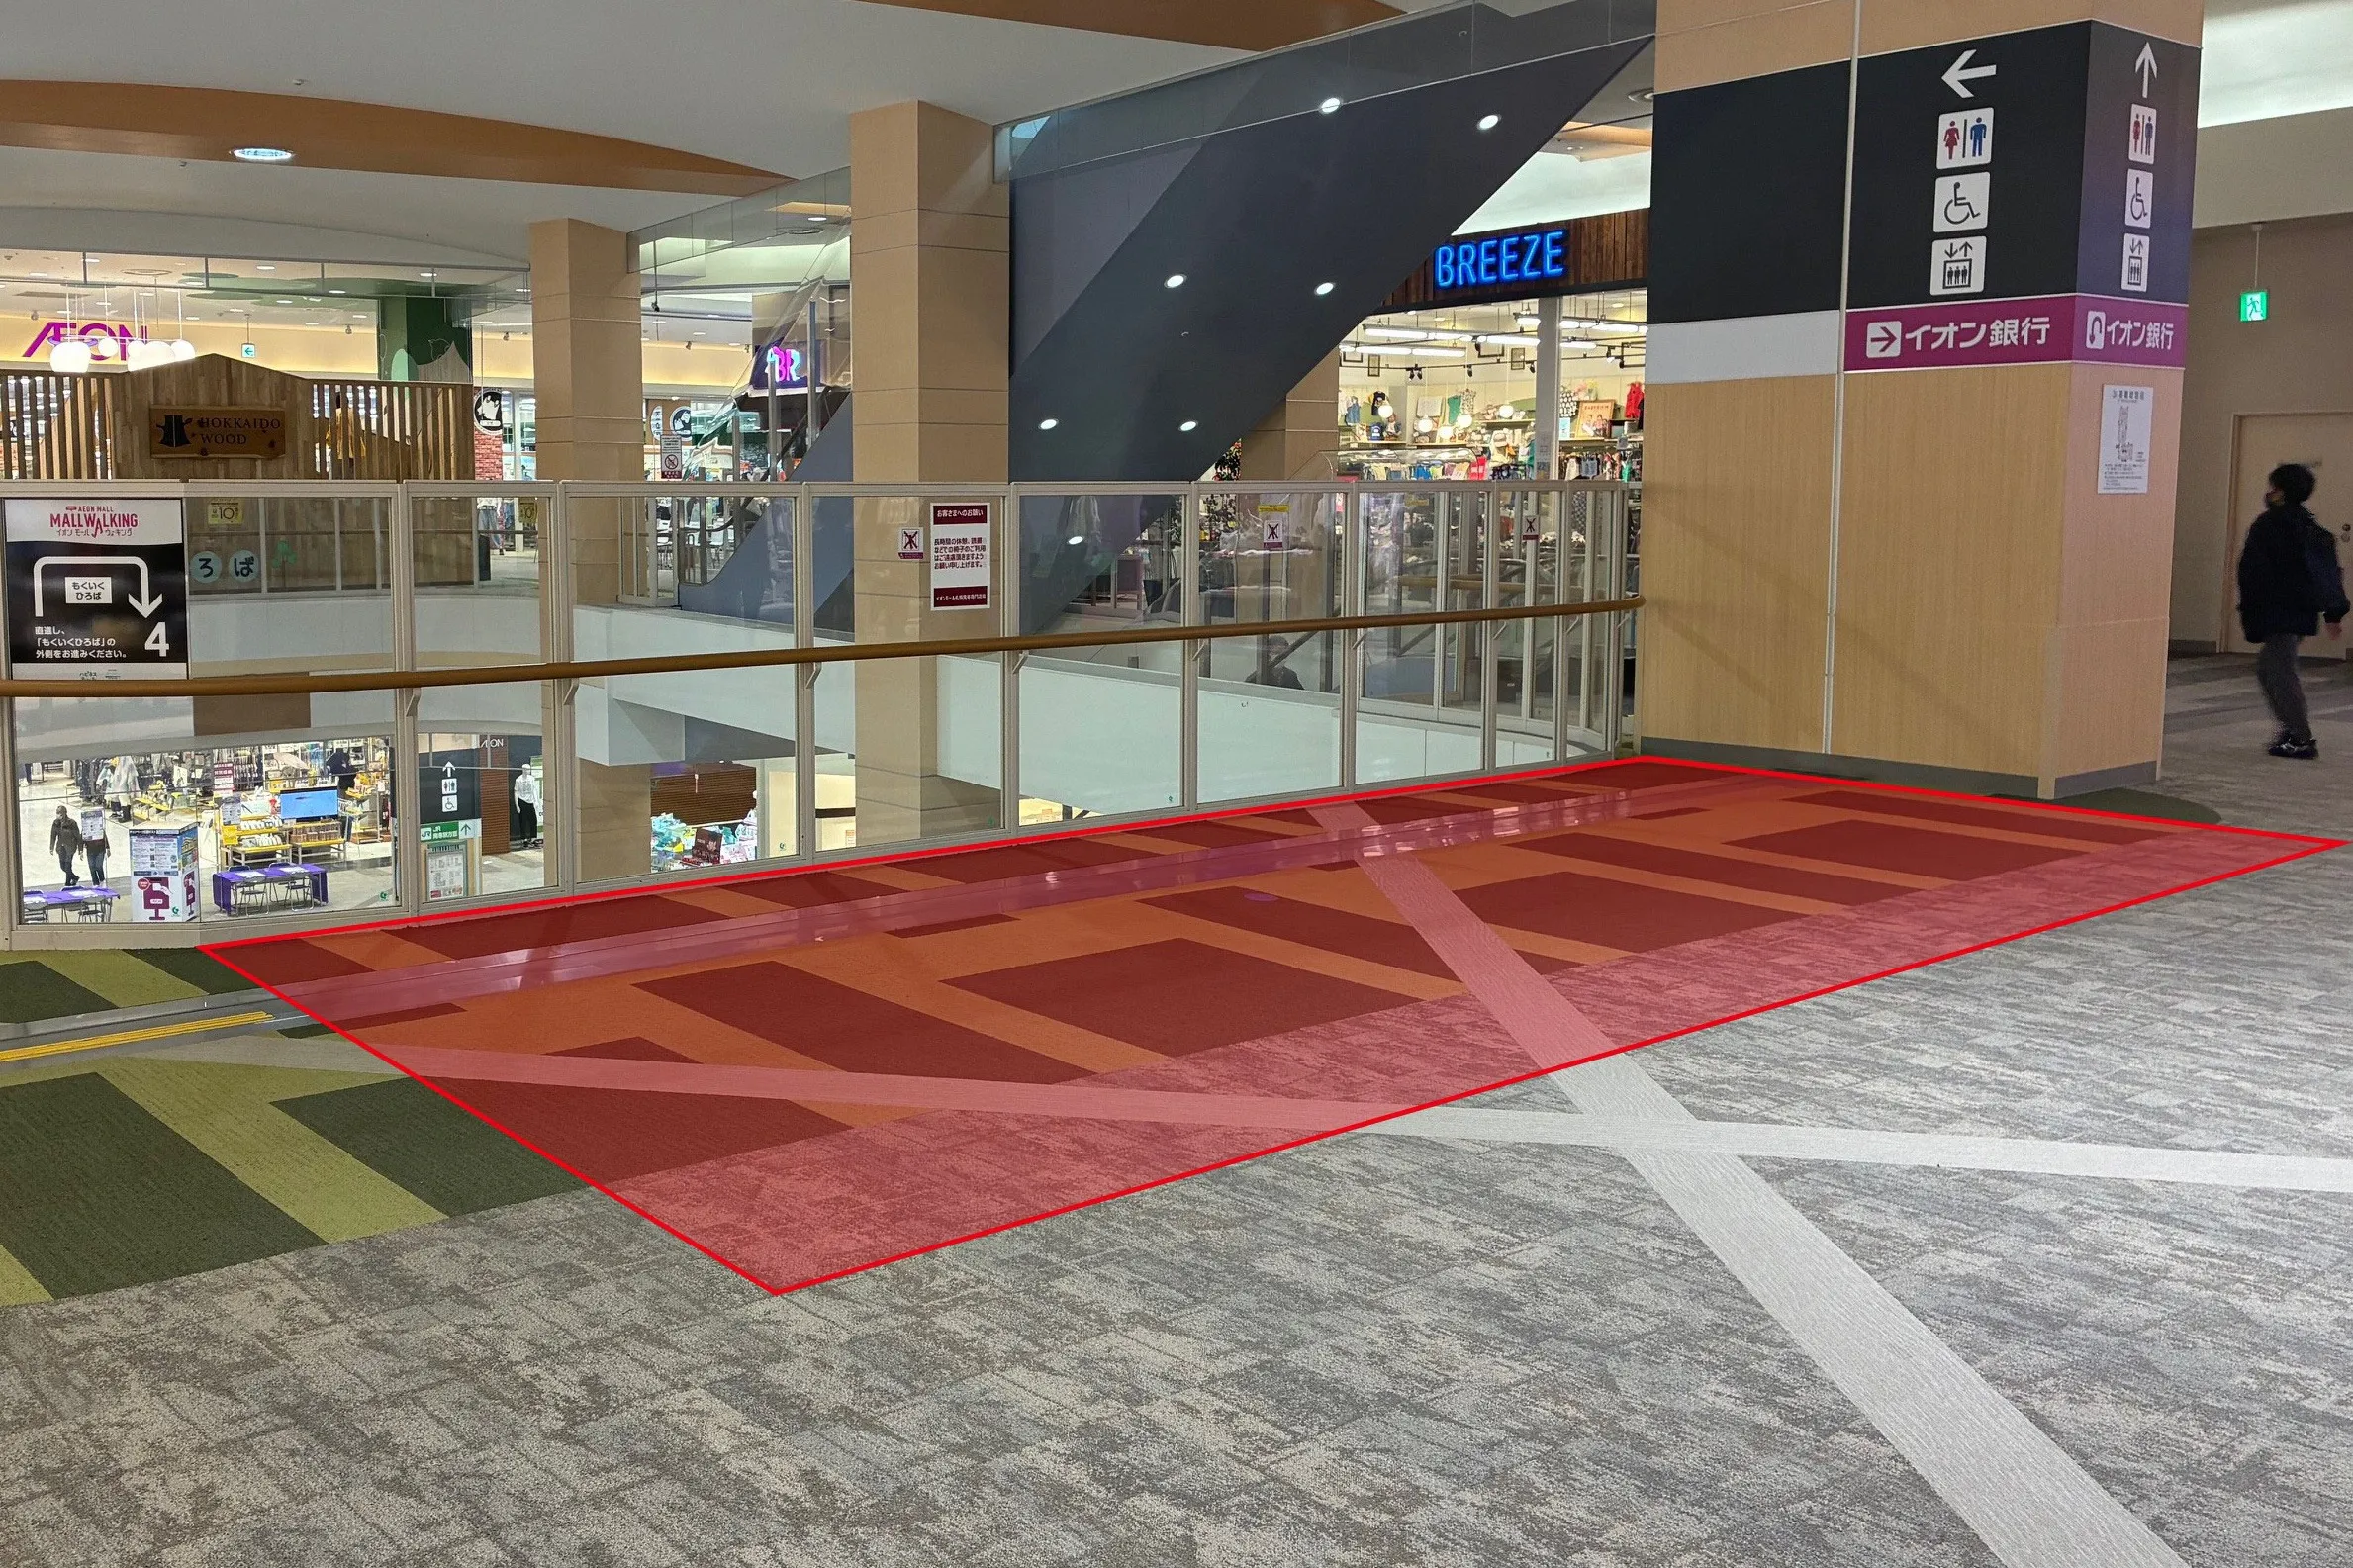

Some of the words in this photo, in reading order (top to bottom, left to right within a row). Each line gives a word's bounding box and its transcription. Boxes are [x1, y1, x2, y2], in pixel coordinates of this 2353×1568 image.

[1435, 230, 1563, 287] BREEZE
[1906, 317, 2050, 350] イオン銀行
[2106, 319, 2174, 350] イオン銀行
[200, 417, 281, 429] HOKKAIDO
[201, 434, 247, 445] WOOD
[71, 581, 105, 590] もくいく
[75, 591, 102, 600] ひろば
[35, 626, 65, 635] 直進し、
[37, 637, 116, 647] 「もくいくひろば」の
[144, 621, 170, 657] 4
[35, 649, 127, 658] 外側をお進みください。
[481, 738, 504, 748] AON
